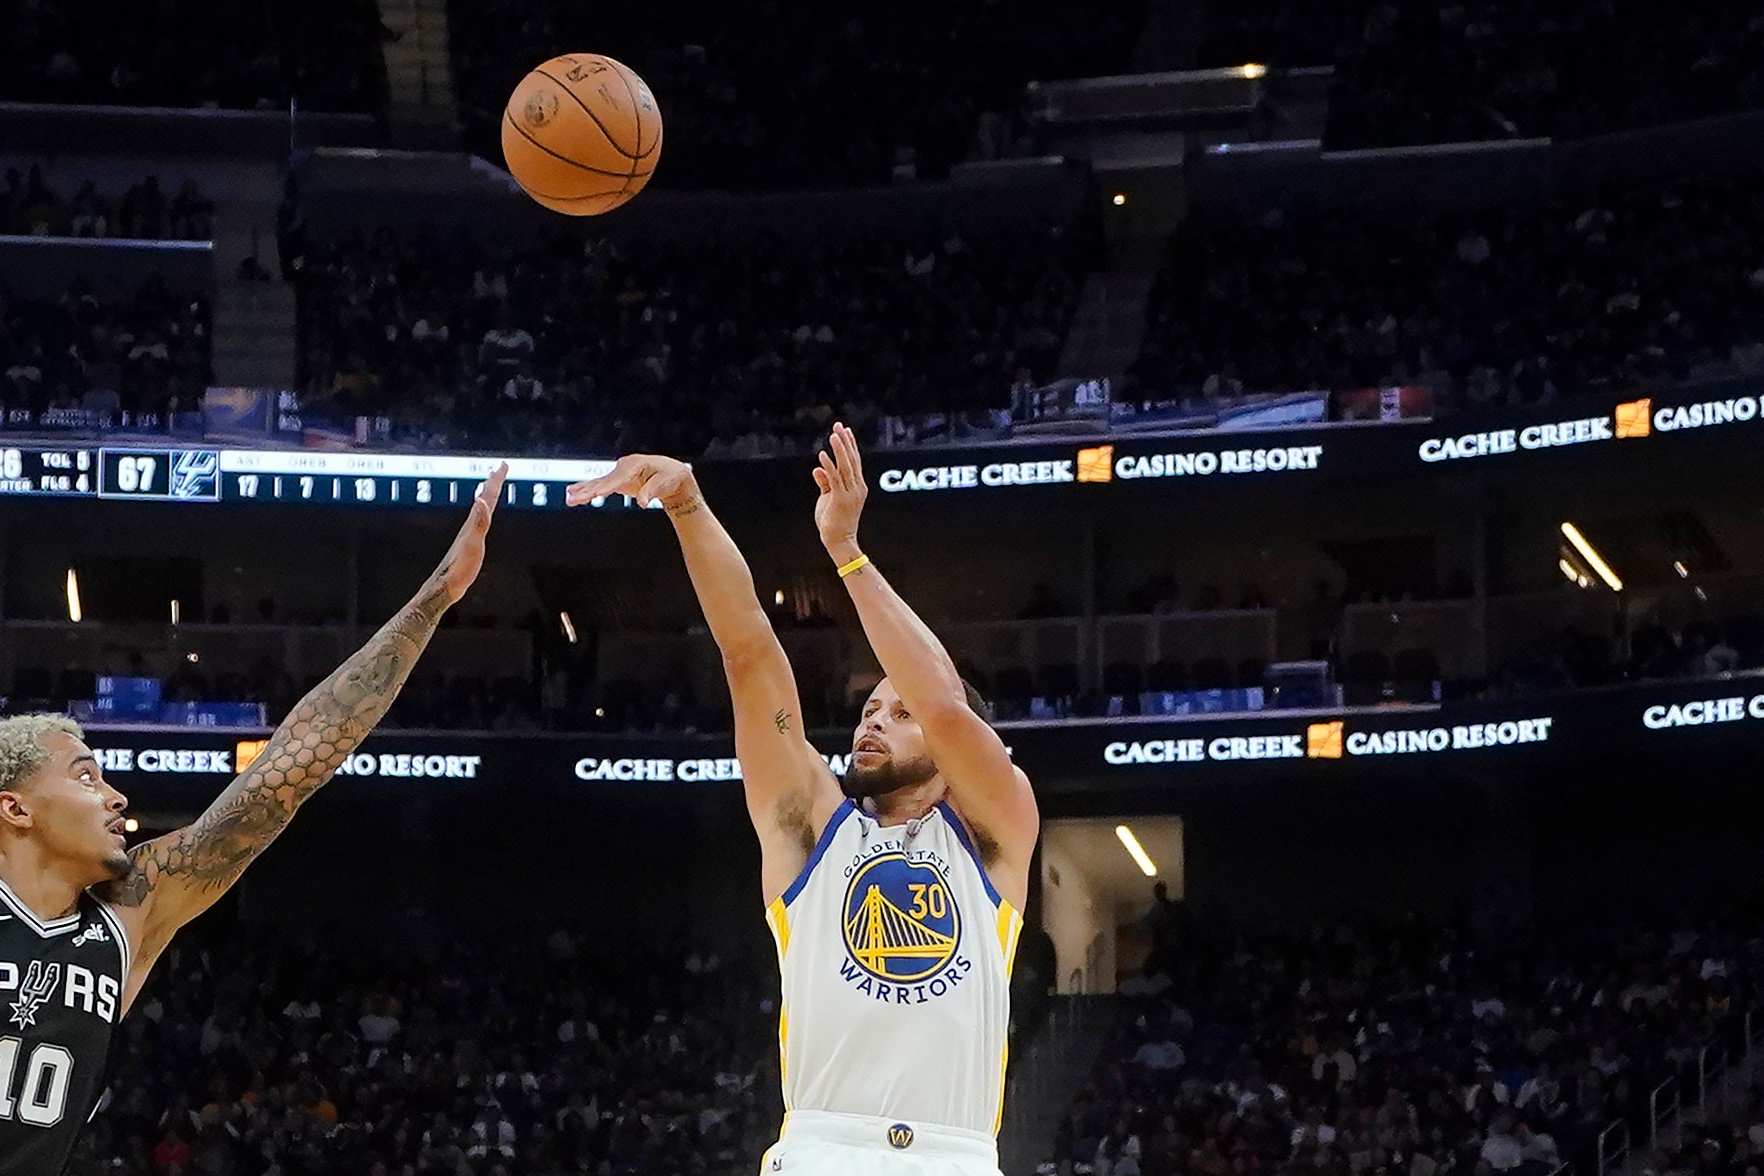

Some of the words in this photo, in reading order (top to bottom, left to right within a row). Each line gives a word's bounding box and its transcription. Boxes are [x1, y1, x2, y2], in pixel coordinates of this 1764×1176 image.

[1419, 429, 1516, 462] CACHE
[1519, 417, 1613, 449] CREEK
[1654, 396, 1757, 431] CASINO
[41, 452, 72, 469] TOL
[118, 456, 156, 492] 67
[879, 465, 978, 492] CACHE
[981, 460, 1074, 486] CREEK
[1115, 452, 1218, 479] CASINO
[1220, 446, 1323, 473] RESORT
[41, 474, 71, 491] FLS
[76, 474, 89, 493] 4
[238, 475, 259, 498] 17
[300, 476, 314, 499] 7
[355, 477, 376, 501] 13
[416, 480, 431, 503] 2
[532, 482, 548, 506] 2
[1643, 696, 1746, 729] CACHE
[1104, 739, 1205, 764] CACHE
[1208, 735, 1304, 760] CREEK
[1346, 727, 1449, 755] CASINO
[1452, 717, 1553, 749] RESORT
[137, 750, 233, 773] CREEK
[379, 754, 481, 778] RESORT
[575, 758, 675, 781] CACHE
[844, 839, 905, 878] GOLDEN
[906, 850, 952, 878] STATE
[908, 884, 946, 920] 30
[839, 954, 972, 1005] WARRIORS
